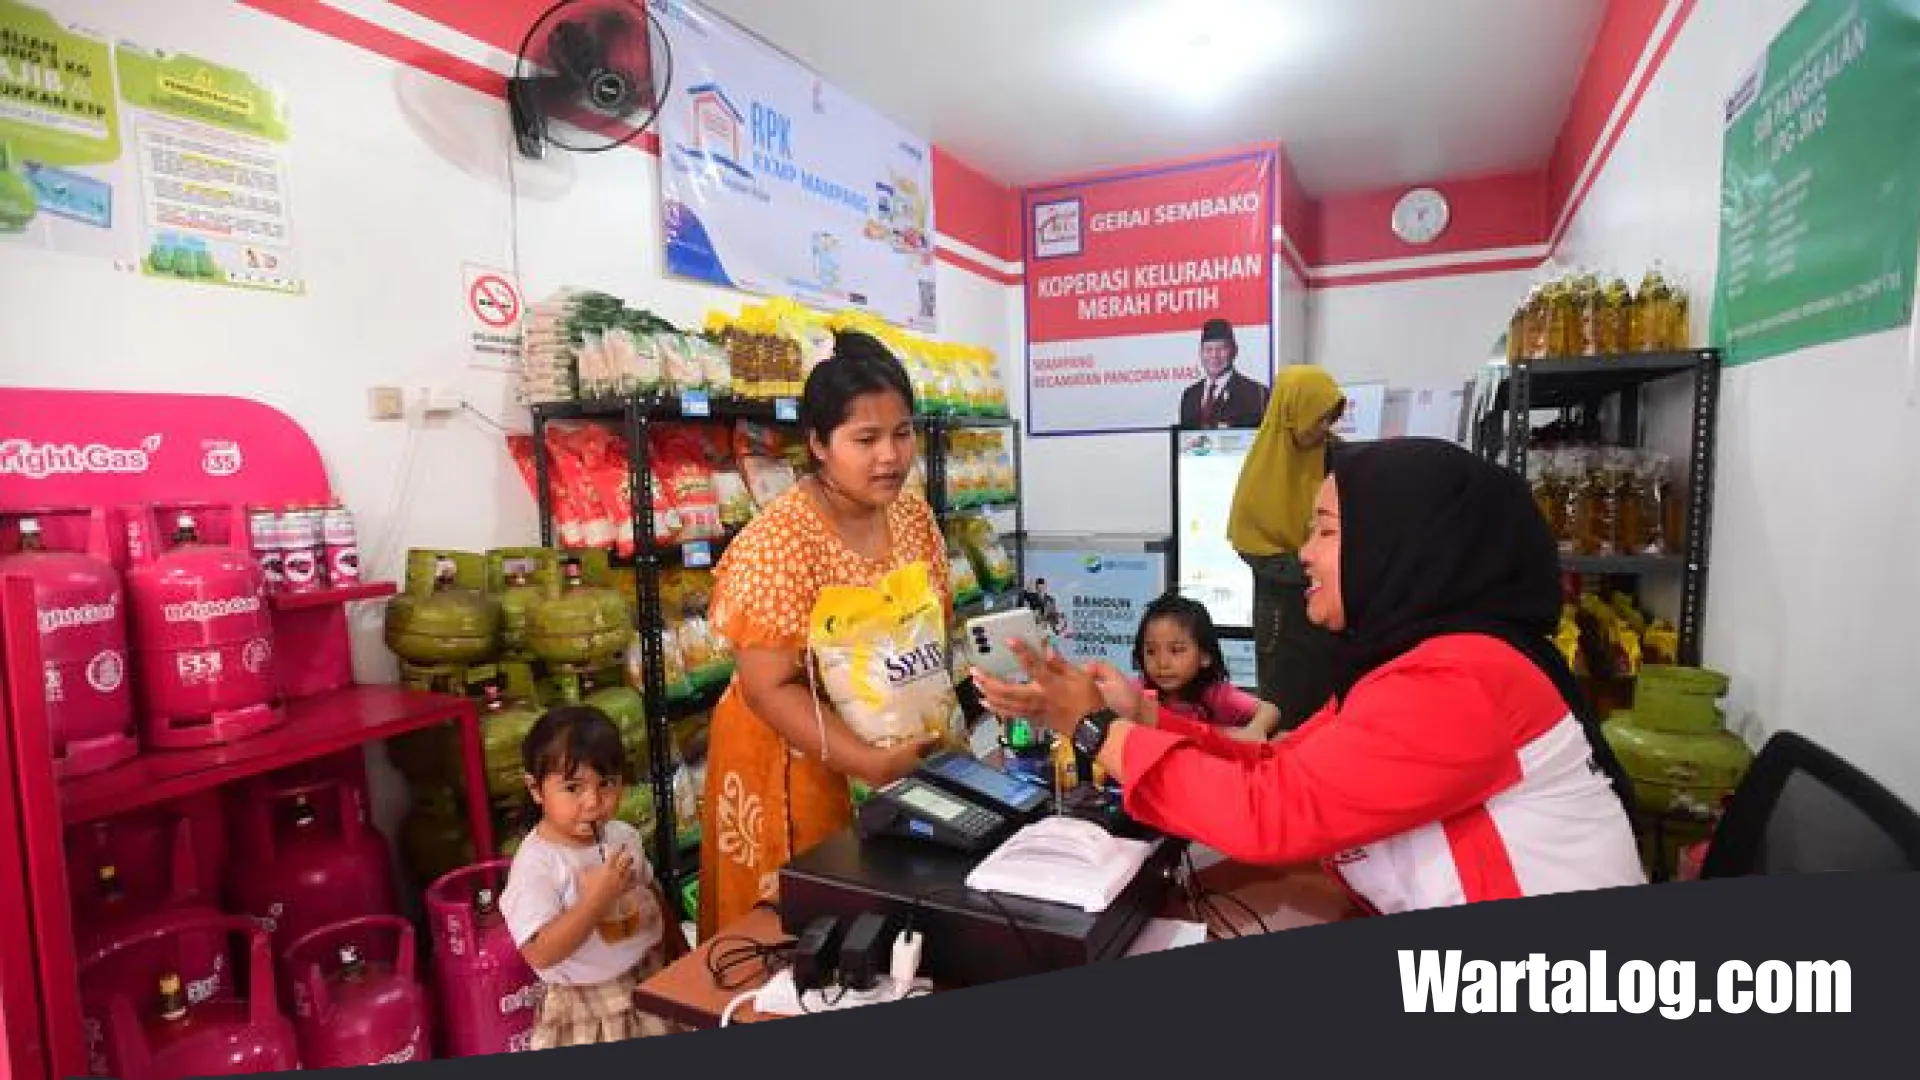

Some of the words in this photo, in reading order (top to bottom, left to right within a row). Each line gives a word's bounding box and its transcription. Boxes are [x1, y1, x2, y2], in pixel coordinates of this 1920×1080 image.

[73, 101, 106, 118] KTP
[751, 101, 791, 159] RPK
[1090, 207, 1150, 233] GERAI
[1155, 191, 1260, 225] SEMBAKO
[1037, 267, 1129, 298] KOPERASI
[1134, 253, 1263, 289] KELURAHAN
[1077, 293, 1151, 321] MERAH
[1155, 286, 1220, 314] PUTIH
[1033, 371, 1102, 389] KECAMATAN
[1103, 367, 1172, 385] PANCORAN
[1072, 595, 1131, 609] BANGUN
[885, 640, 942, 684] SPH
